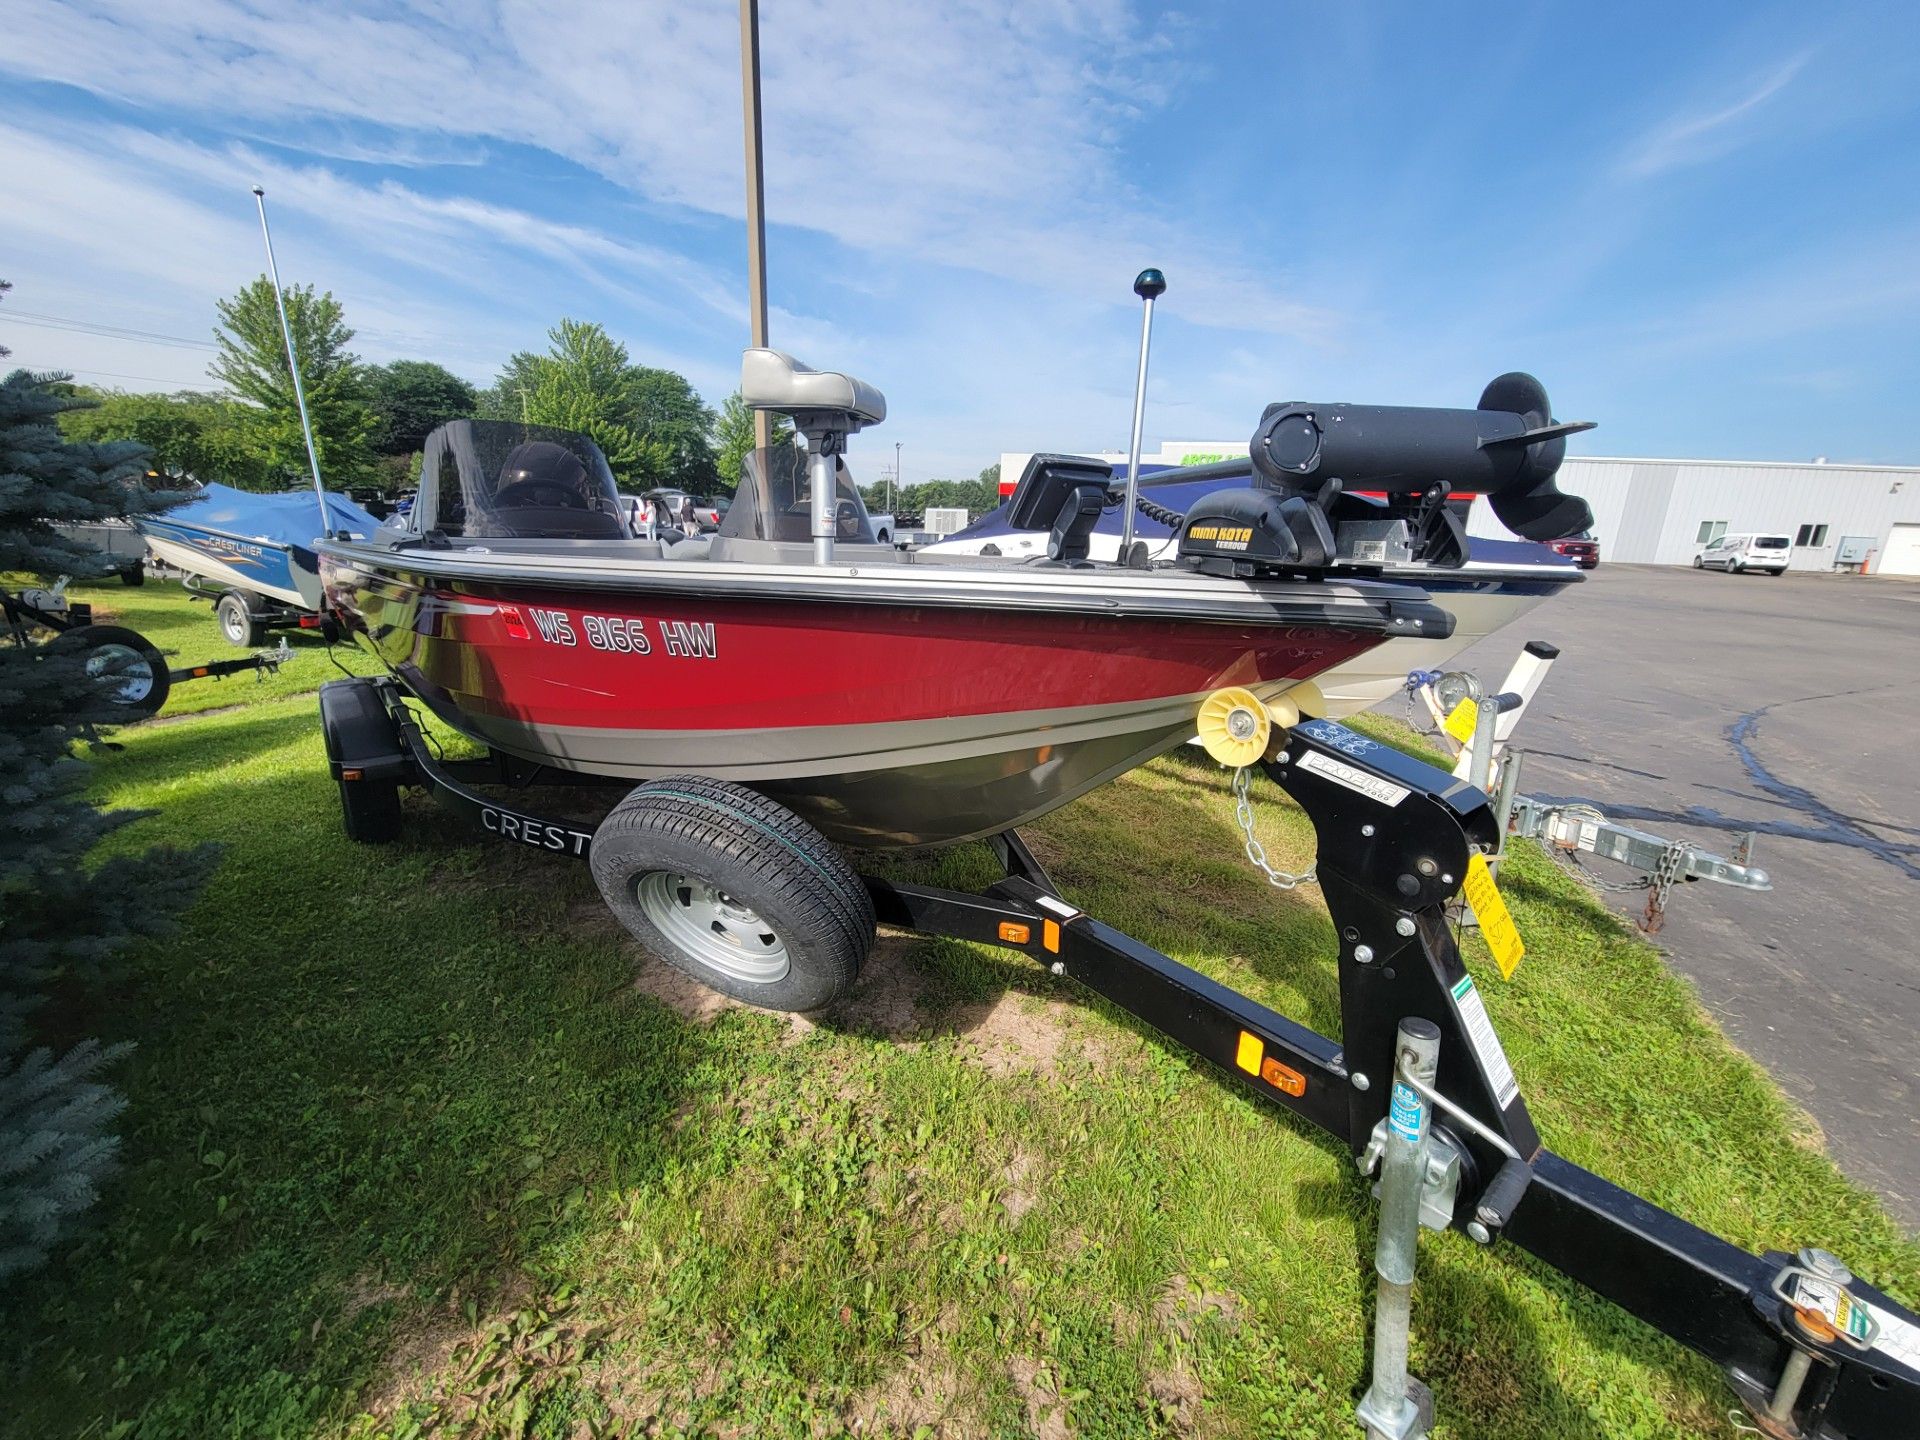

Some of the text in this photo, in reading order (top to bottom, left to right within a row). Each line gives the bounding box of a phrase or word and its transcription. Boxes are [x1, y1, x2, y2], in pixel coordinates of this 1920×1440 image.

[209, 538, 262, 556] CRESTLINER
[1218, 528, 1253, 542] KOTA
[529, 608, 717, 658] WS 8166 HW
[1309, 755, 1398, 798] PROFILE
[481, 808, 592, 855] CREST
